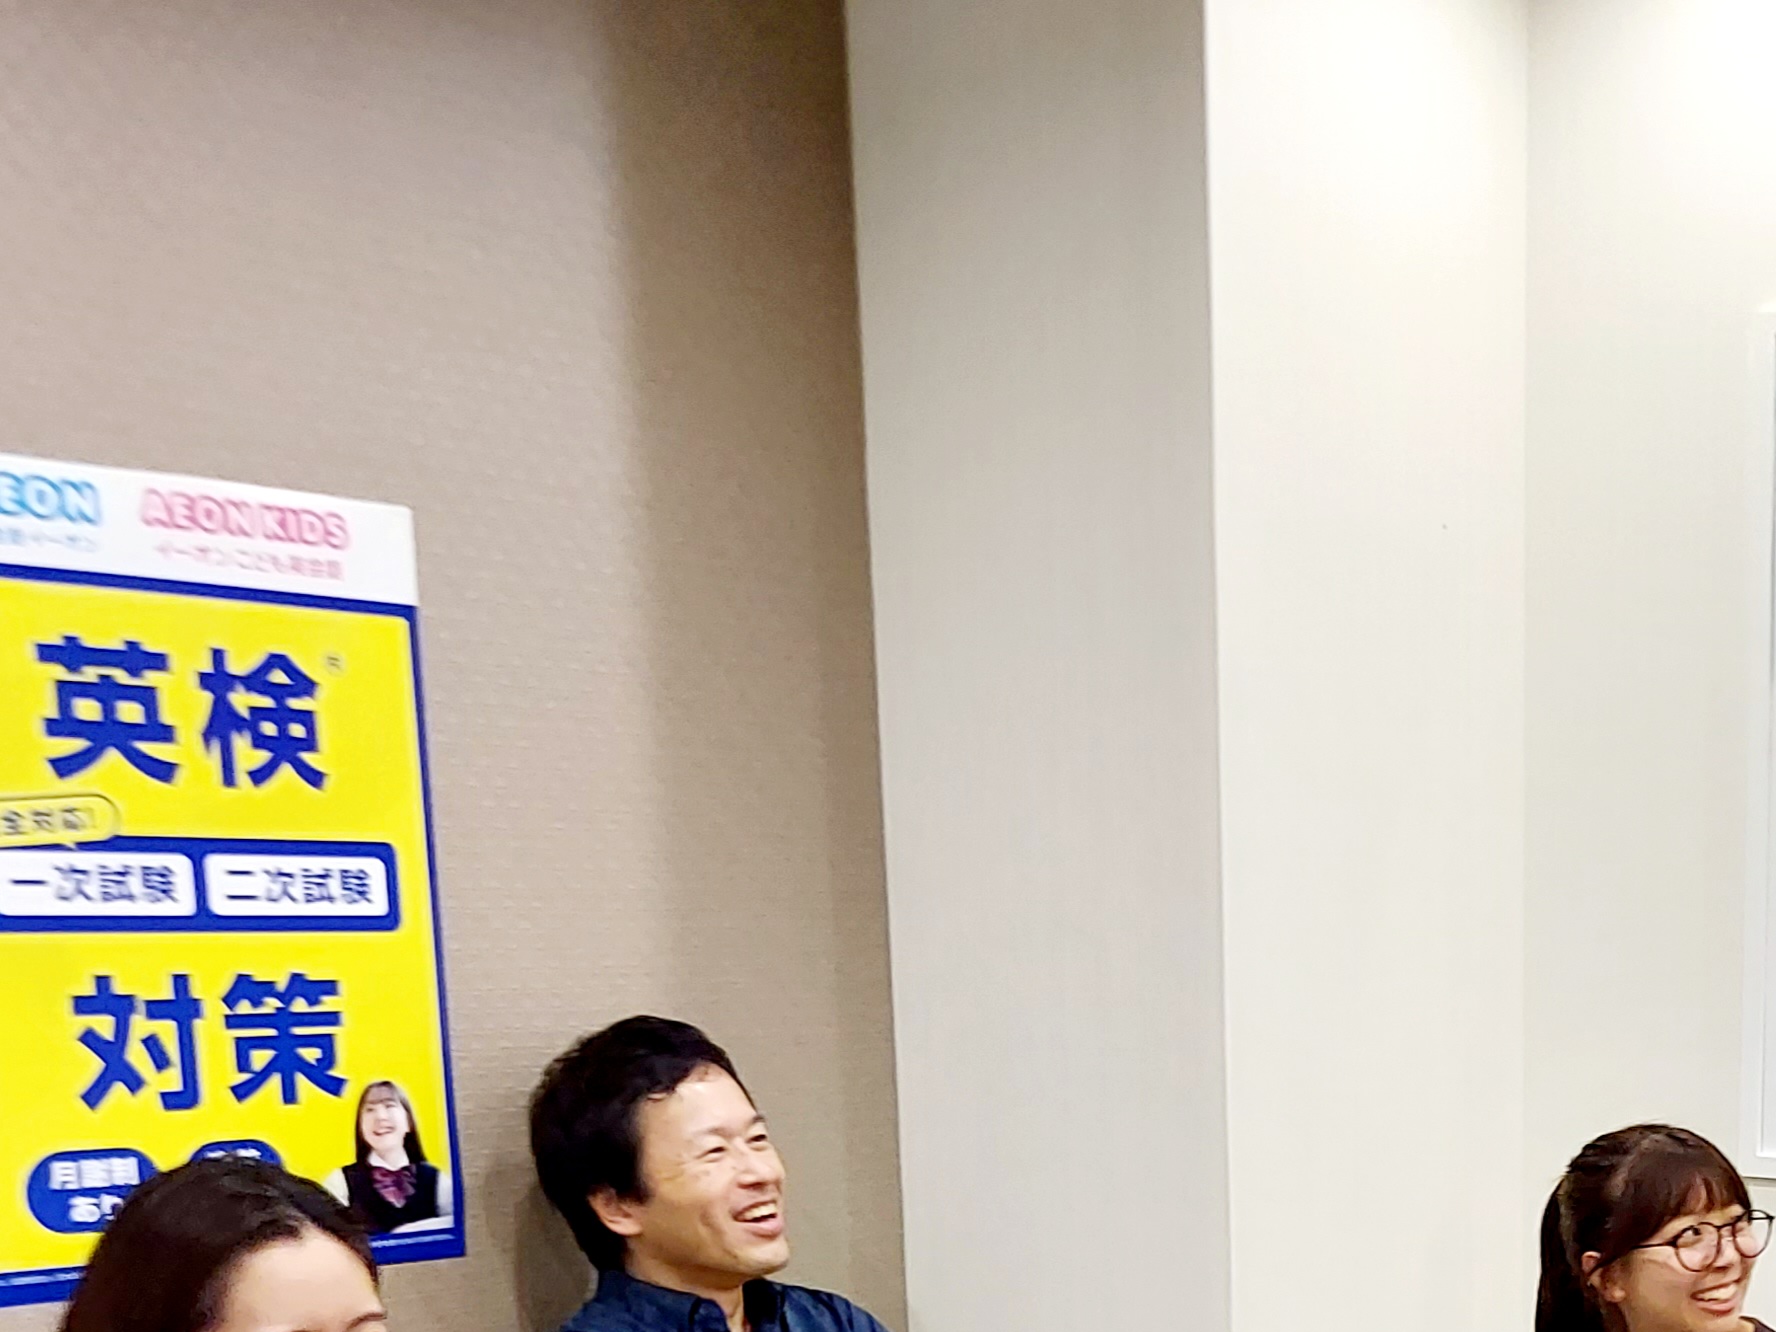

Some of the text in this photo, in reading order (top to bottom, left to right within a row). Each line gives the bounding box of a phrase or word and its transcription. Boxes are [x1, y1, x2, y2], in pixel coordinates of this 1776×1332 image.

[142, 487, 350, 550] AEON KIDS
[11, 864, 179, 904] 一次試験
[226, 867, 374, 905] 二次試験
[72, 972, 350, 1112] 対策
